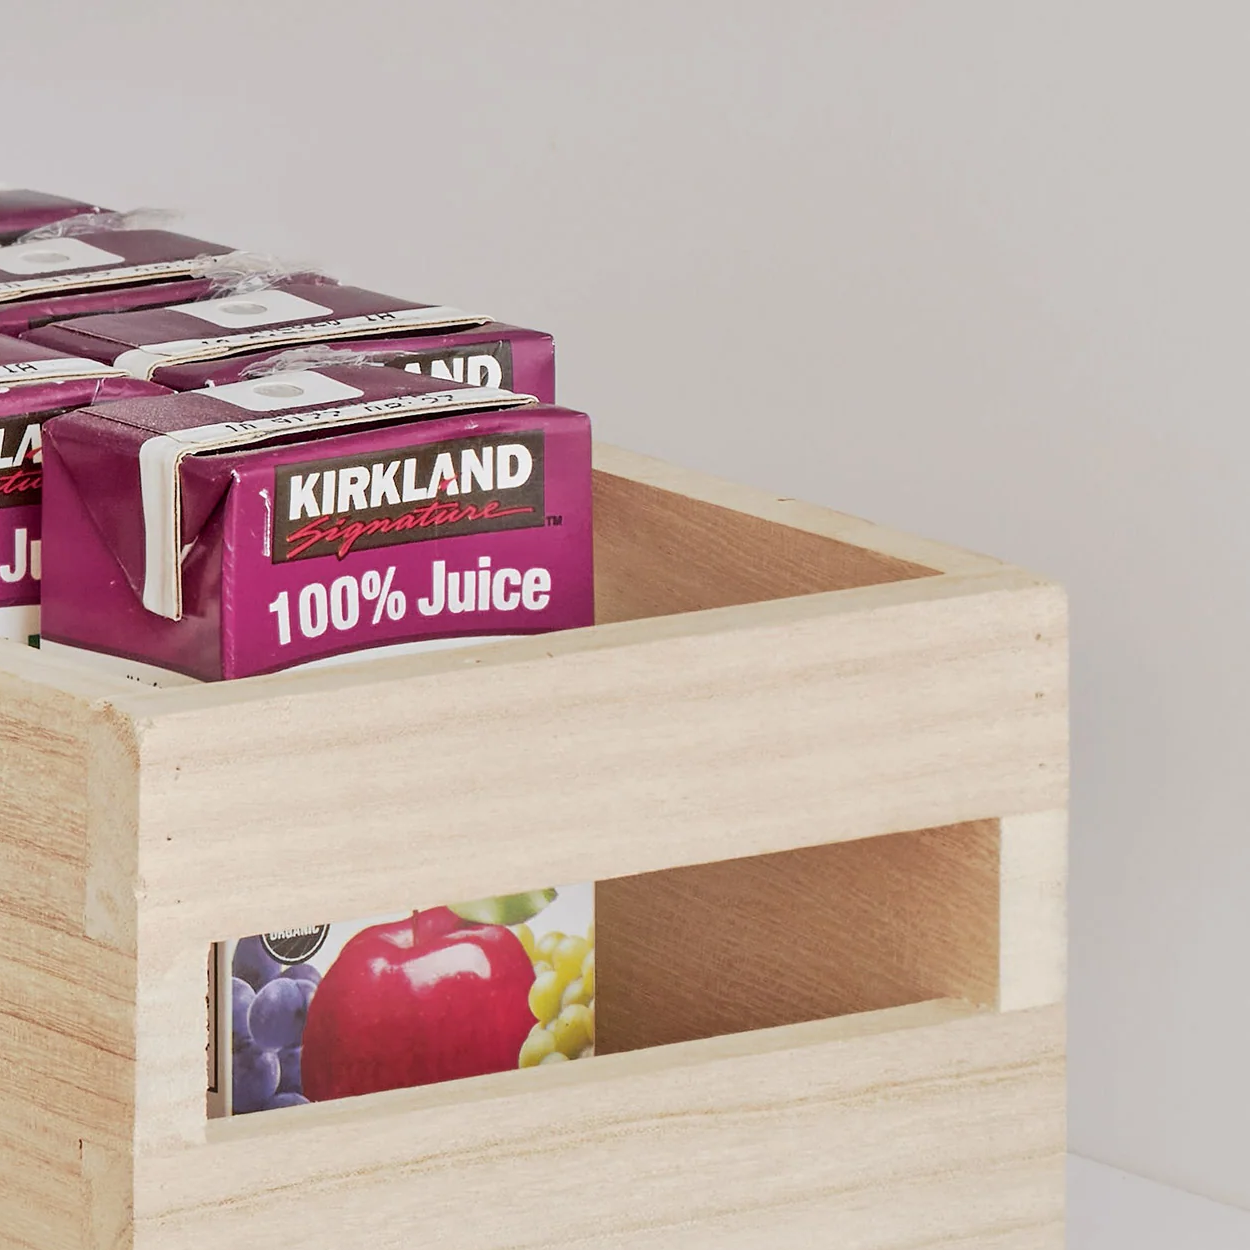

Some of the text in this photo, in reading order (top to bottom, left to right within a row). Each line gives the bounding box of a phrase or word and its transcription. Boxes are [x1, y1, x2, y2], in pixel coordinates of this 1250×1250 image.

[288, 443, 533, 521] KIRKLAND
[285, 500, 535, 560] Signature
[268, 556, 552, 646] 100% Juice
